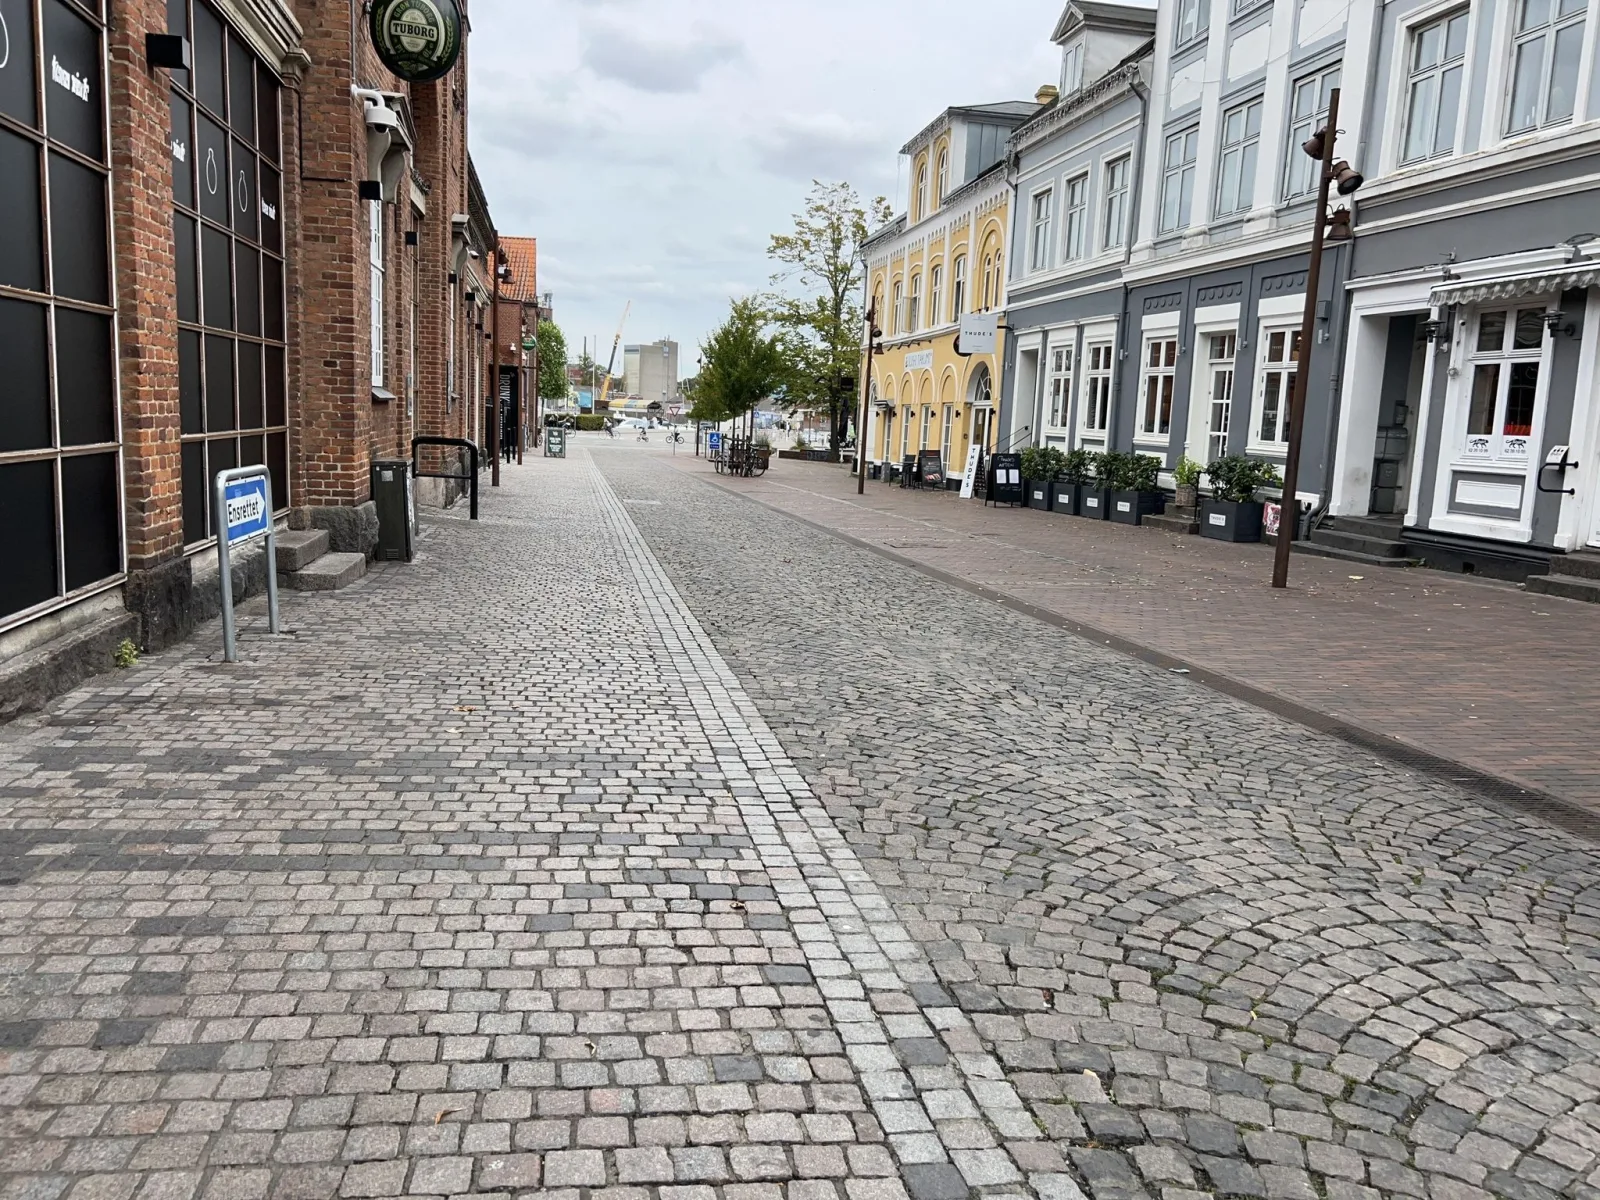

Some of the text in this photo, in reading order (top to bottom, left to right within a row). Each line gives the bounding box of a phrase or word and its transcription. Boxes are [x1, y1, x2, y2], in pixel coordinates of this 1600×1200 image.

[394, 0, 435, 23] GRØN TUBORG
[393, 23, 434, 38] TUBORG
[228, 499, 259, 523] Ensrettet
